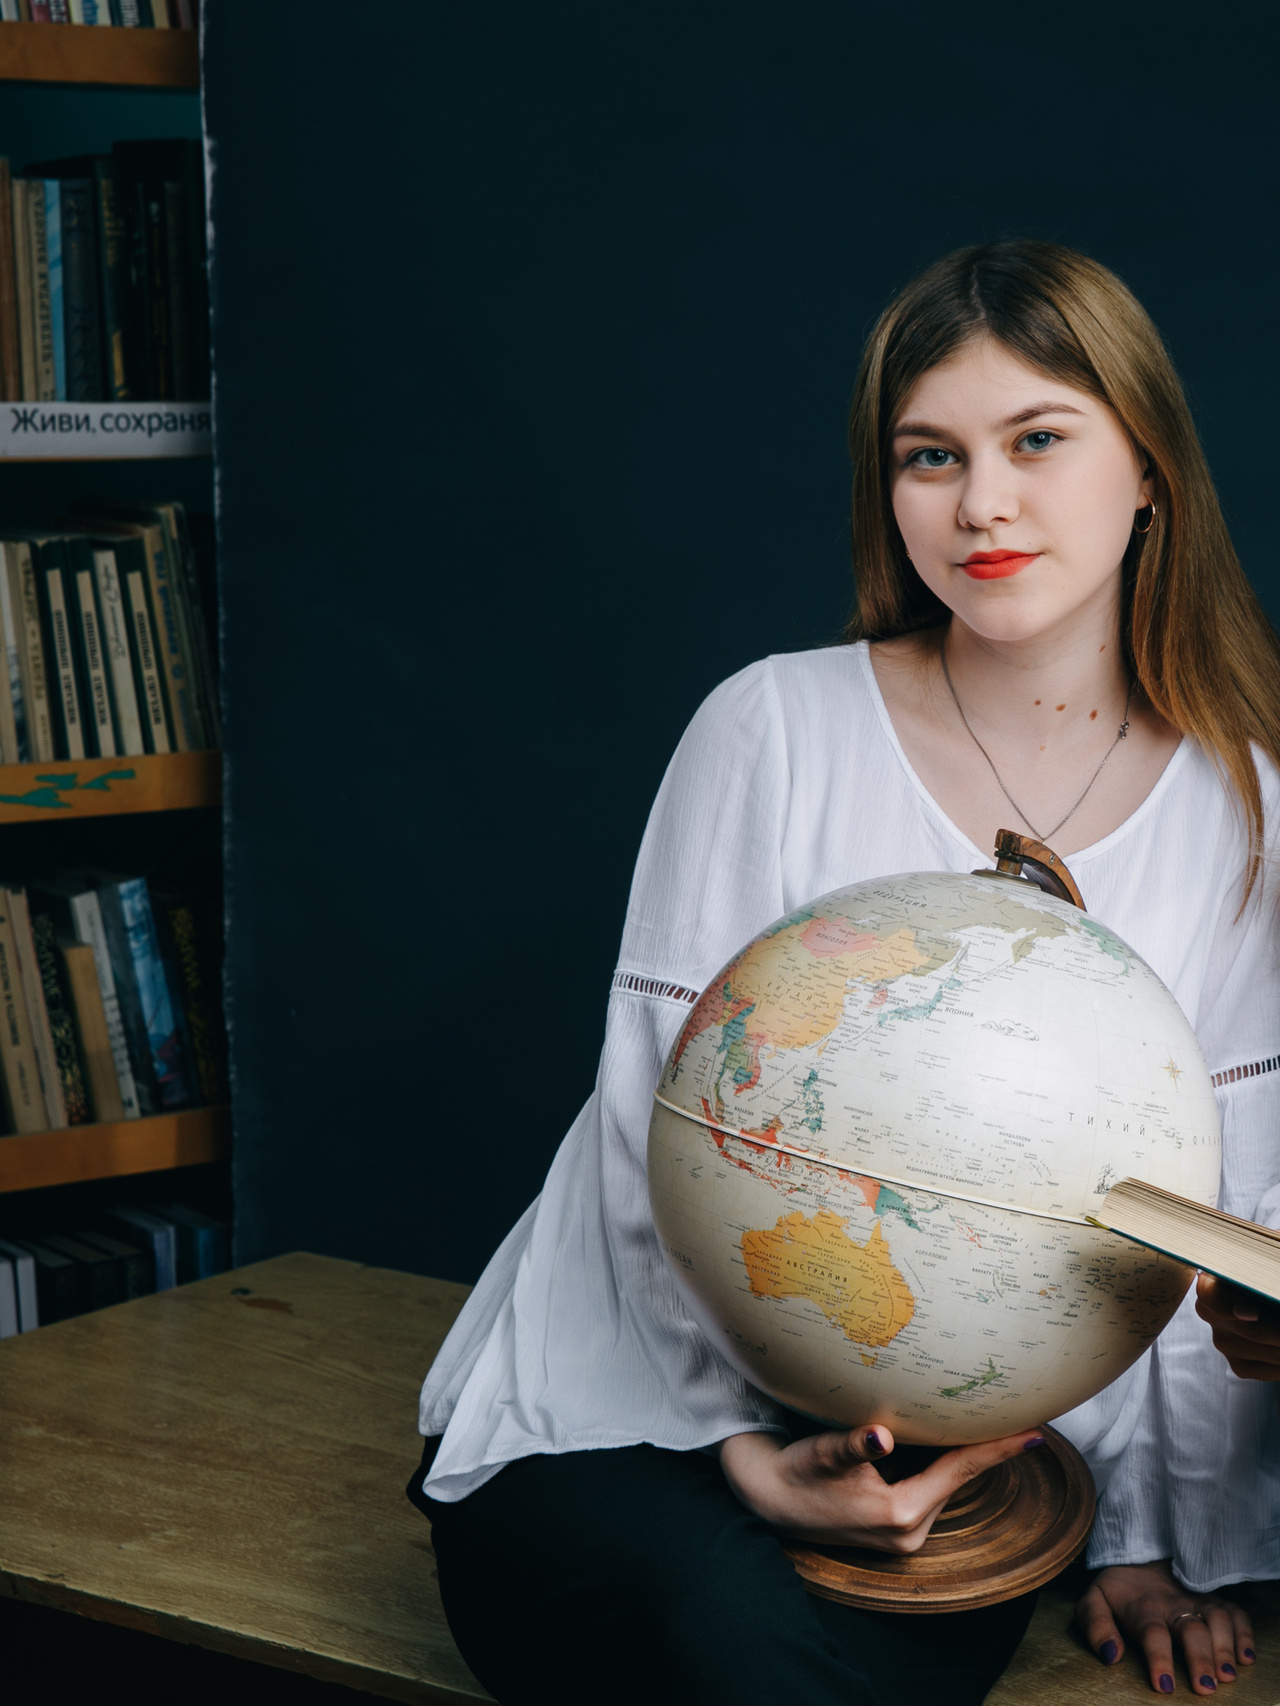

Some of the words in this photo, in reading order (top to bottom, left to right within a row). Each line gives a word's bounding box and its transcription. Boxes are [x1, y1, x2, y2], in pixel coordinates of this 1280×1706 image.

[873, 890, 927, 909] ФЕДЕРАЦИЯ
[816, 932, 848, 945] МОНГОЛИЯ
[944, 1006, 974, 1018] ЯПОНИЯ
[843, 1105, 874, 1117] ФИЛИППИНСКОЕ
[1068, 1112, 1146, 1136] ТИХИЙ
[999, 1131, 1031, 1142] МАРШАЛЛОВЫ
[1004, 1139, 1025, 1148] ОСТРОВА
[906, 1165, 938, 1178] ФЕДЕРАТИВНЫЕ
[938, 1173, 955, 1181] ШТАТЫ
[955, 1177, 983, 1187] МИКРОНЕЗИИ
[989, 1232, 1018, 1243] СОЛОМОНОВЫ
[993, 1238, 1012, 1247] ОСТРОВА
[817, 1251, 851, 1264] ТЕРРИТОРИЯ
[915, 1250, 948, 1261] КОРАЛЛОВОЕ
[786, 1260, 848, 1283] АВСТРАЛИЯ
[972, 1267, 992, 1275] ВАНУАТУ
[908, 1351, 945, 1365] ТАСМАНОВО
[915, 1361, 932, 1370] МОРЕ
[943, 1369, 960, 1377] НОВАЯ
